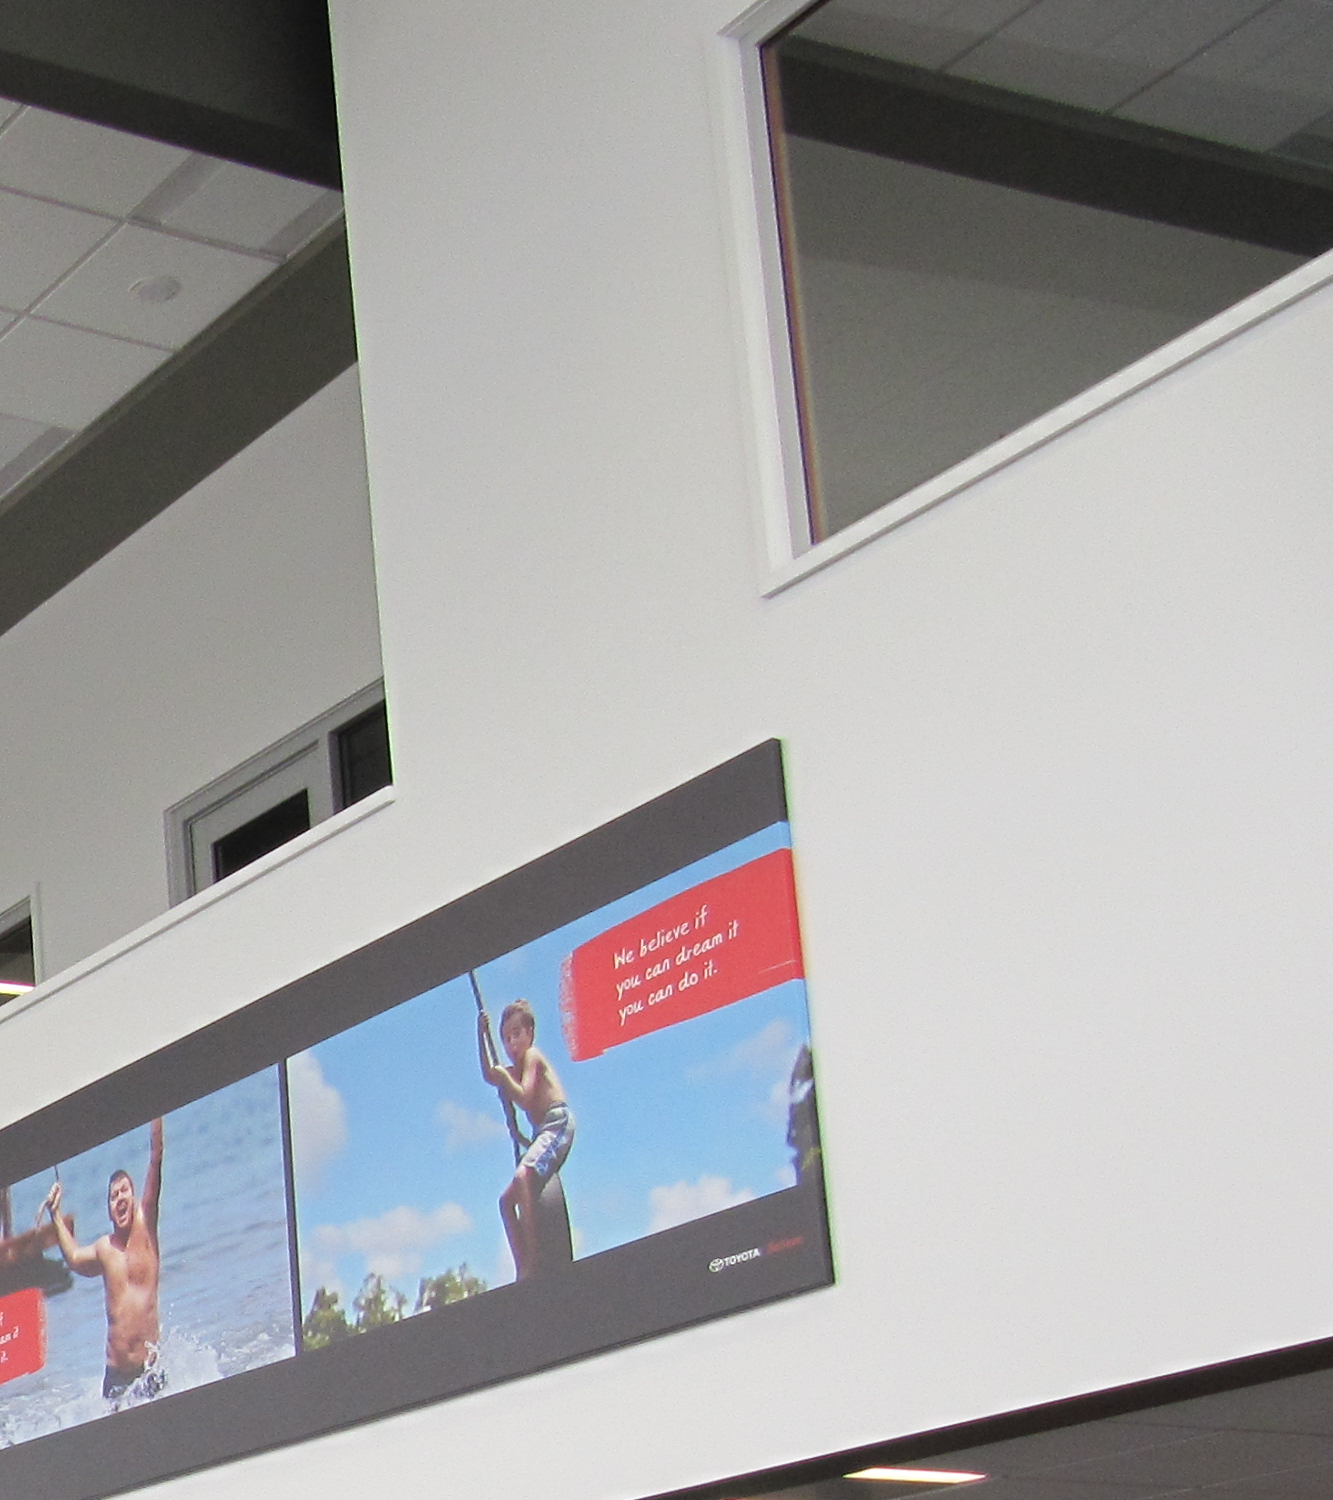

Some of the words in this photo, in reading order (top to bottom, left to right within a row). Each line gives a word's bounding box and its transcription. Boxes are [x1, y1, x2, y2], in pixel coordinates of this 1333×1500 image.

[613, 948, 634, 969] We
[640, 922, 690, 957] believe
[694, 904, 707, 929] if
[616, 975, 641, 1001] you
[645, 959, 670, 980] can
[675, 933, 723, 965] dream
[728, 919, 739, 940] it
[619, 1000, 644, 1026] you
[648, 984, 673, 1005] can
[678, 972, 698, 991] do
[704, 960, 718, 979] it.
[724, 1248, 761, 1267] TOYOTA
